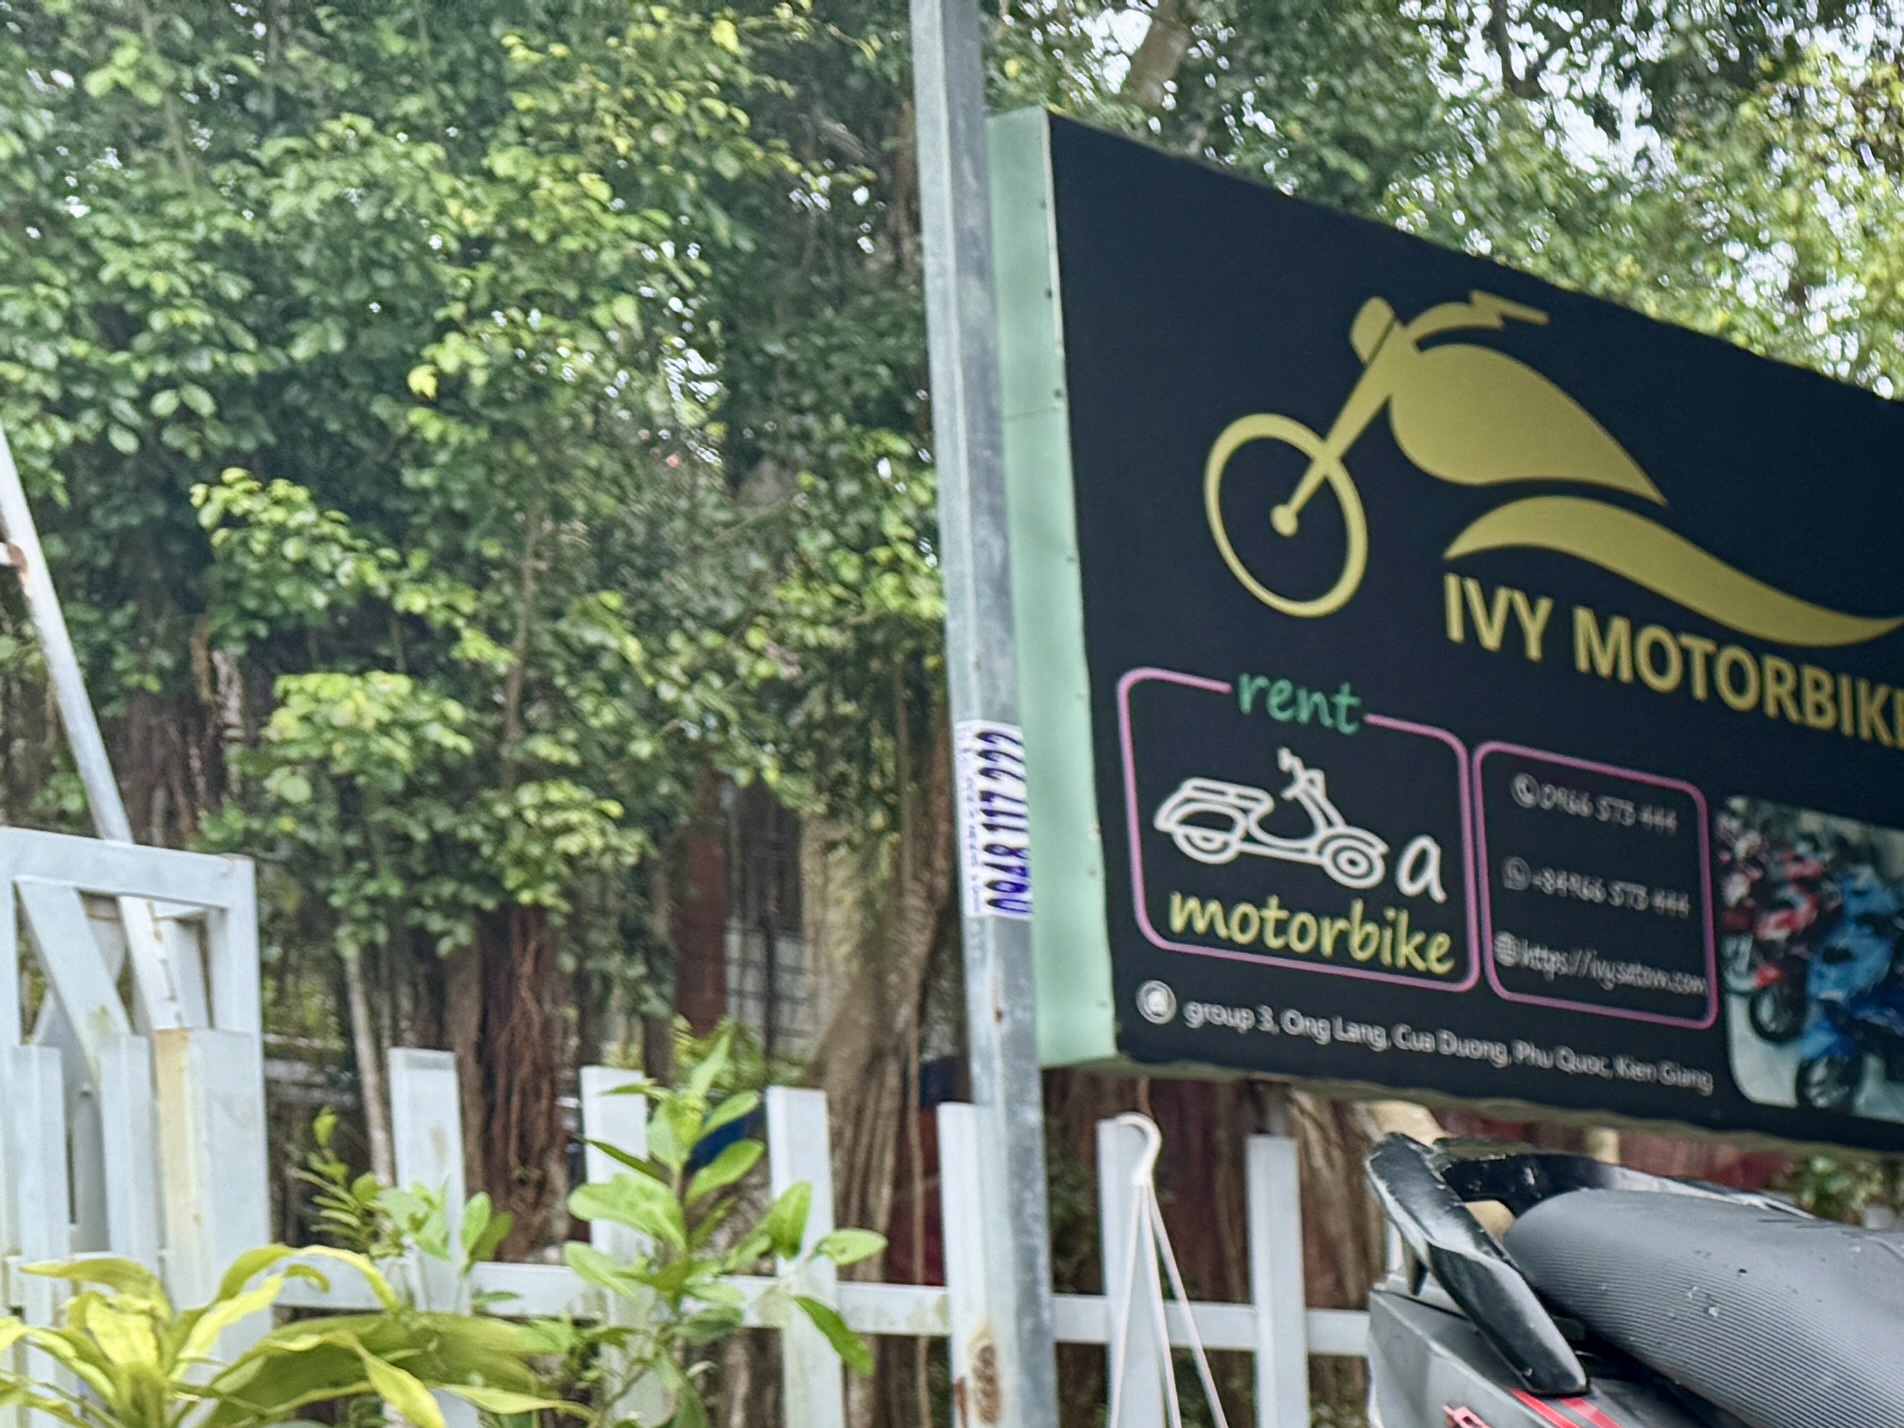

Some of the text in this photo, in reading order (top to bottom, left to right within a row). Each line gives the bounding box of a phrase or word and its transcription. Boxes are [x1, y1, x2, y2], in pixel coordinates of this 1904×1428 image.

[1443, 573, 1554, 662] IVY
[1238, 672, 1363, 735] rent
[1395, 834, 1448, 903] a
[1168, 890, 1455, 975] motorbike
[1182, 1001, 1255, 1034] group
[1280, 1008, 1331, 1045] Ong
[1332, 1015, 1391, 1052] Lang,
[1391, 1023, 1436, 1053] Cua
[1512, 1039, 1552, 1069] Phu
